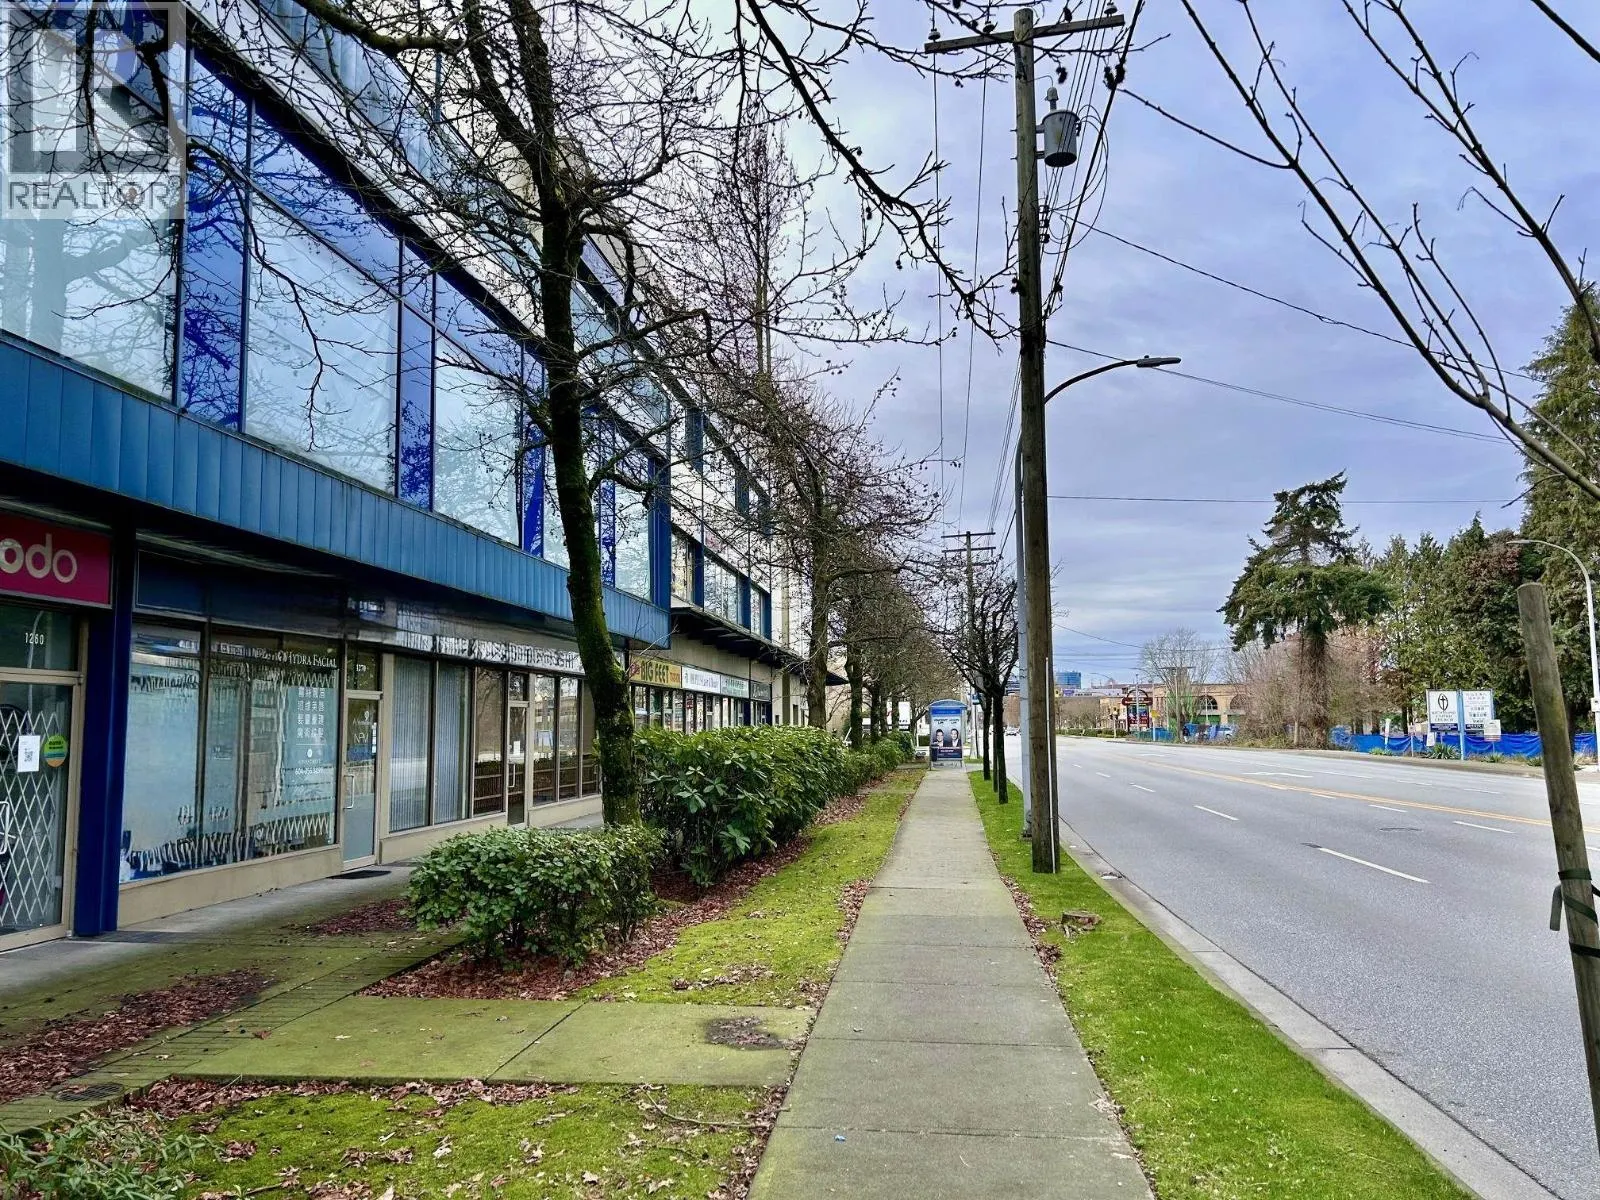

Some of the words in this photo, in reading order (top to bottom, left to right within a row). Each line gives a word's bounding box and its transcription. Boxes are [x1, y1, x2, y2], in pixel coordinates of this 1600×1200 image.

[25, 632, 44, 645] 1260
[313, 654, 337, 668] FACIAL
[640, 660, 654, 682] BIG
[654, 662, 669, 684] FEET
